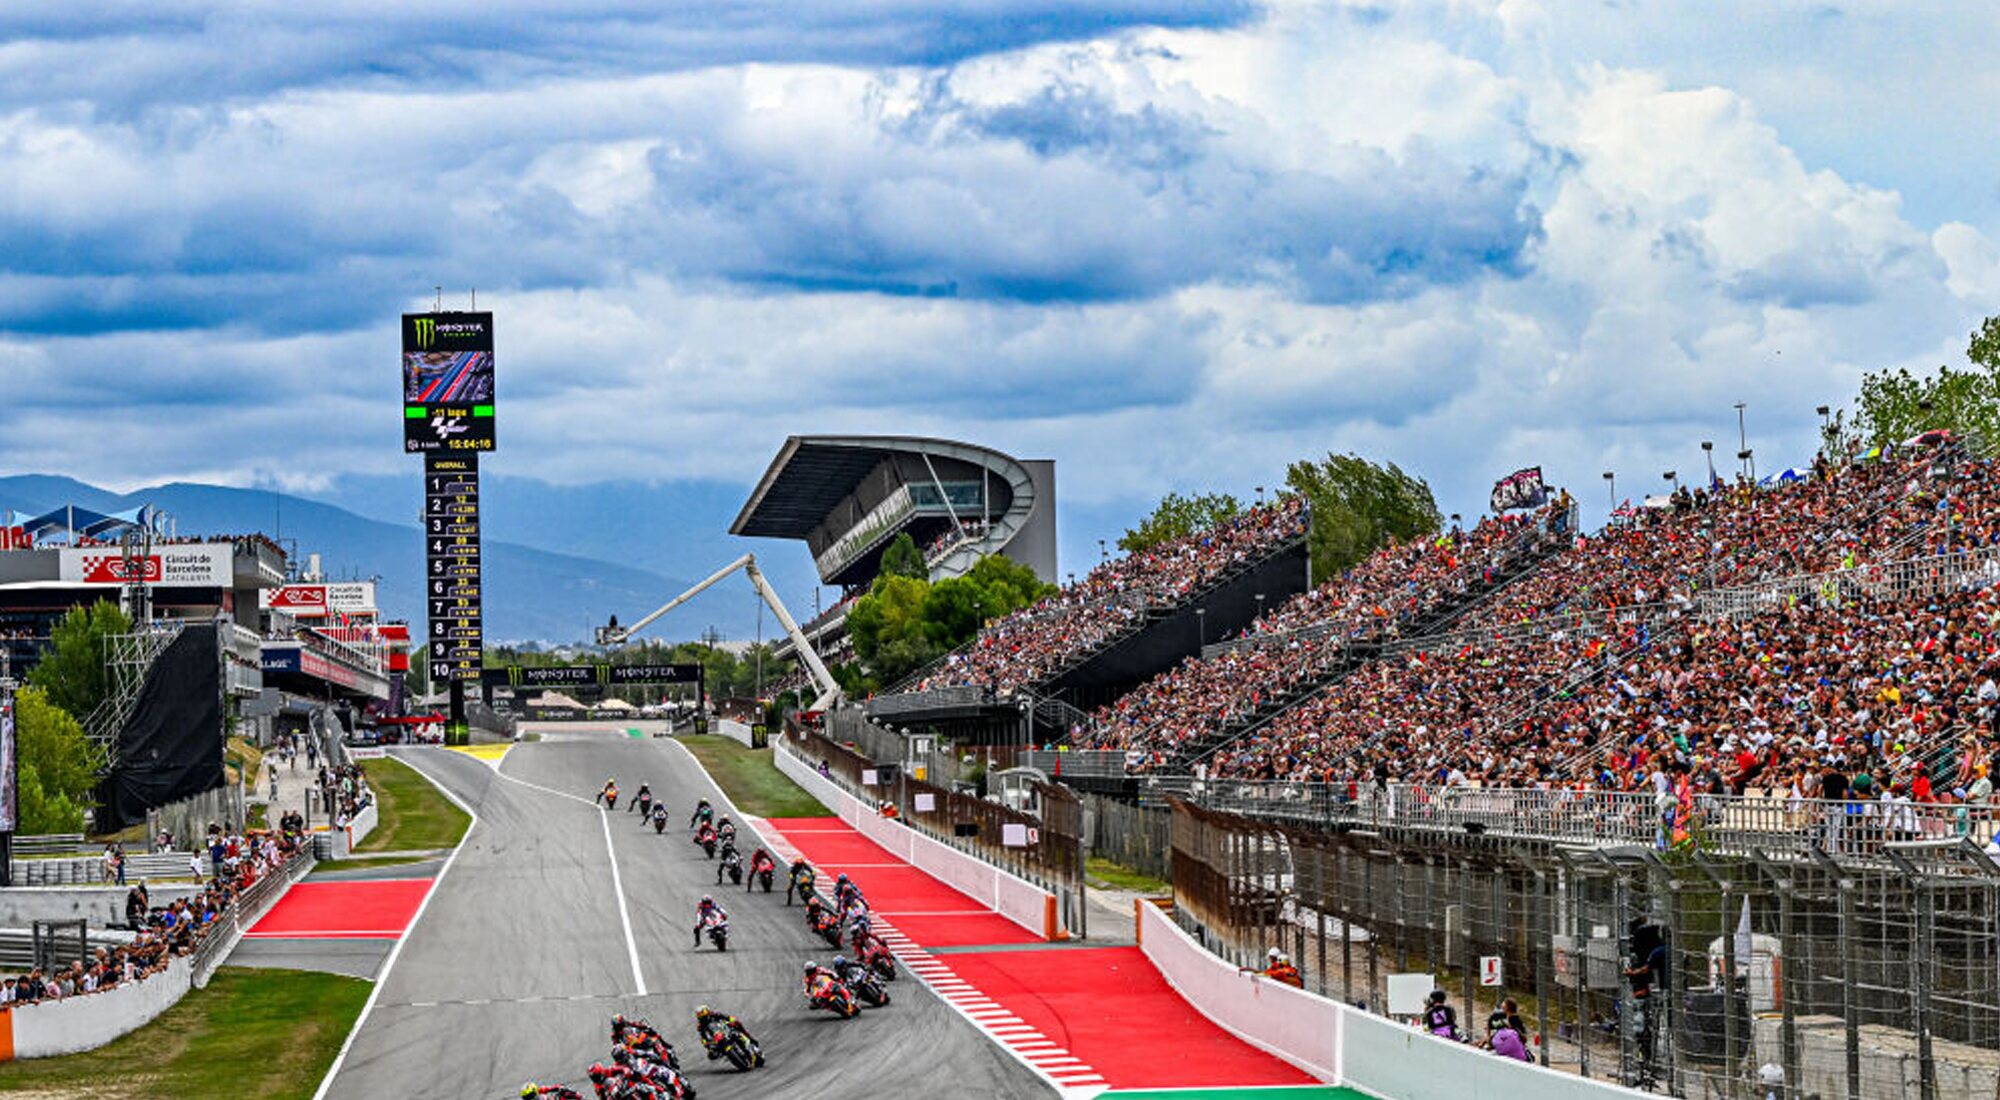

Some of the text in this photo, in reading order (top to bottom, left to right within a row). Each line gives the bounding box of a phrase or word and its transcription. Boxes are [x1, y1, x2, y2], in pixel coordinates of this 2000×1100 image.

[433, 478, 439, 490] 1
[432, 499, 441, 511] 2
[433, 520, 441, 532] 3
[433, 540, 442, 552] 4
[166, 554, 197, 563] Circuit
[166, 565, 211, 573] Barcelona
[434, 560, 443, 573] 5
[434, 581, 443, 593] 6
[435, 602, 443, 614] 7
[435, 622, 443, 635] 8
[435, 643, 445, 656] 9
[432, 663, 449, 676] 10
[528, 669, 588, 680] MONSTER
[615, 667, 676, 678] MONSTER
